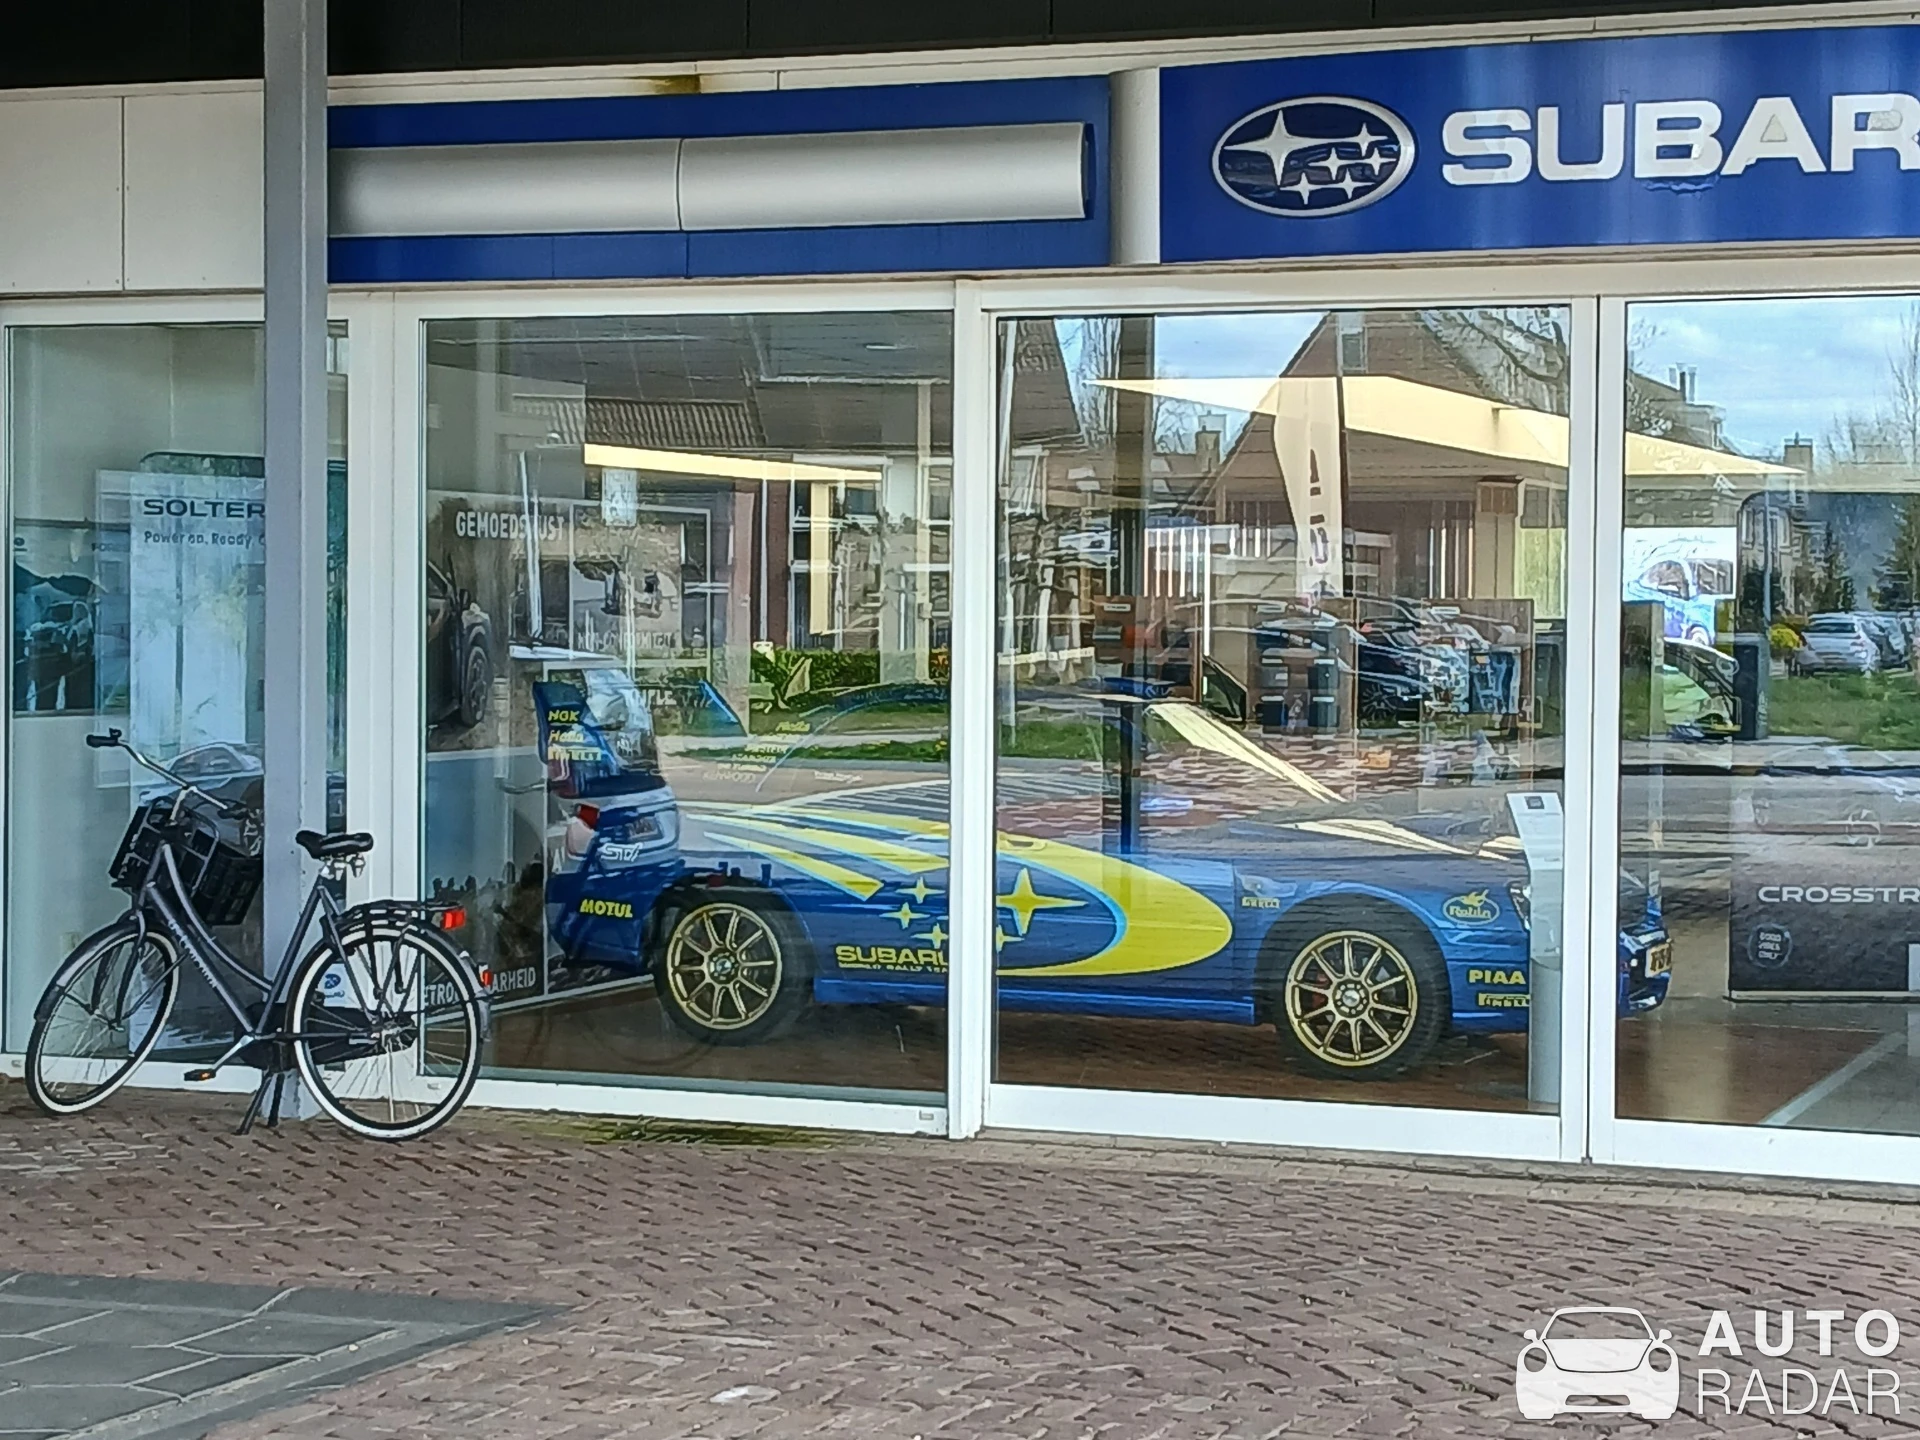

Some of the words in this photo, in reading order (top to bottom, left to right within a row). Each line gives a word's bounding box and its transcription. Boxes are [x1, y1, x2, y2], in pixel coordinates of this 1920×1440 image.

[1442, 93, 1920, 186] SUBAR
[143, 499, 265, 518] SOLTER
[456, 511, 565, 540] GEMOEDSUST
[144, 530, 186, 544] Power
[1758, 886, 1920, 903] CROSSTR
[580, 899, 633, 918] MOTUL
[1469, 970, 1526, 984] PIAA
